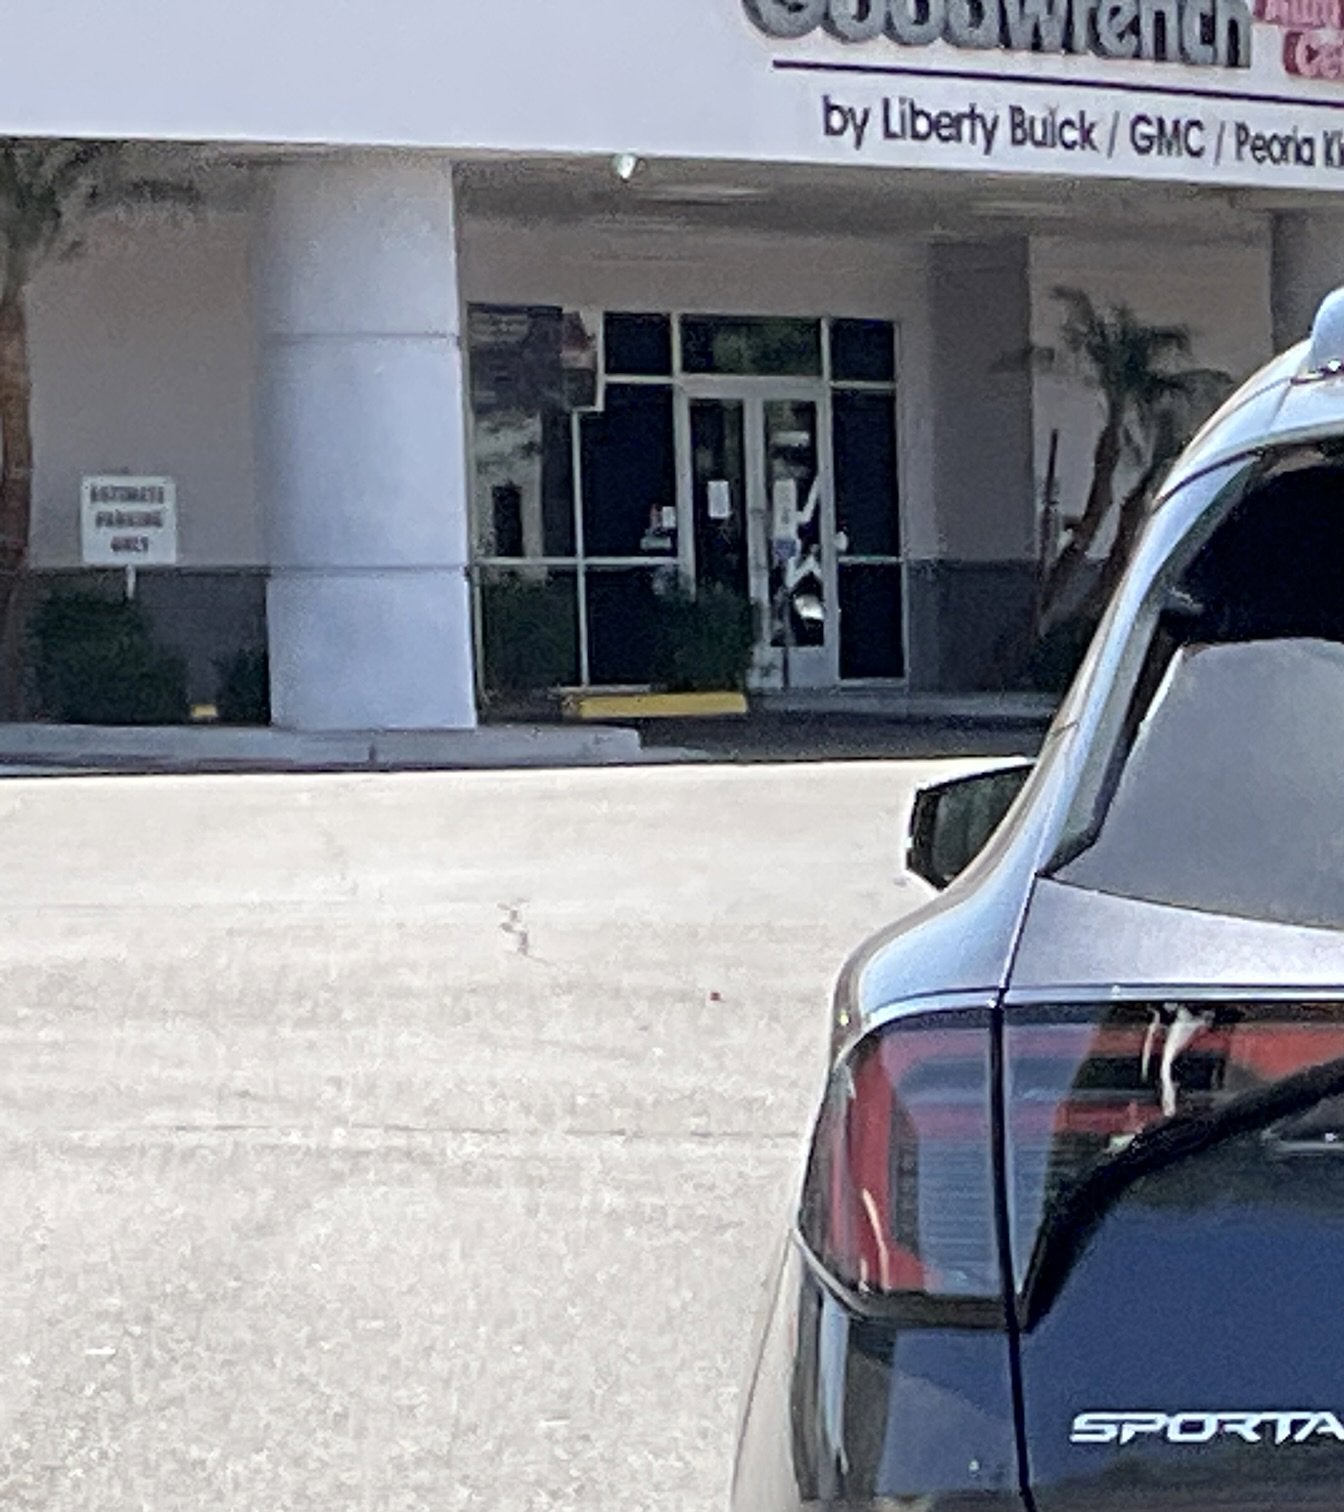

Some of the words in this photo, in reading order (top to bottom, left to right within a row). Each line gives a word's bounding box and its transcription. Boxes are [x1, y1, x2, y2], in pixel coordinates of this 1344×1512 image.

[822, 95, 870, 150] by
[882, 97, 999, 155] Liberty
[1009, 105, 1099, 152] Buick
[1130, 114, 1206, 158] GMC
[1235, 121, 1316, 168] Peoria
